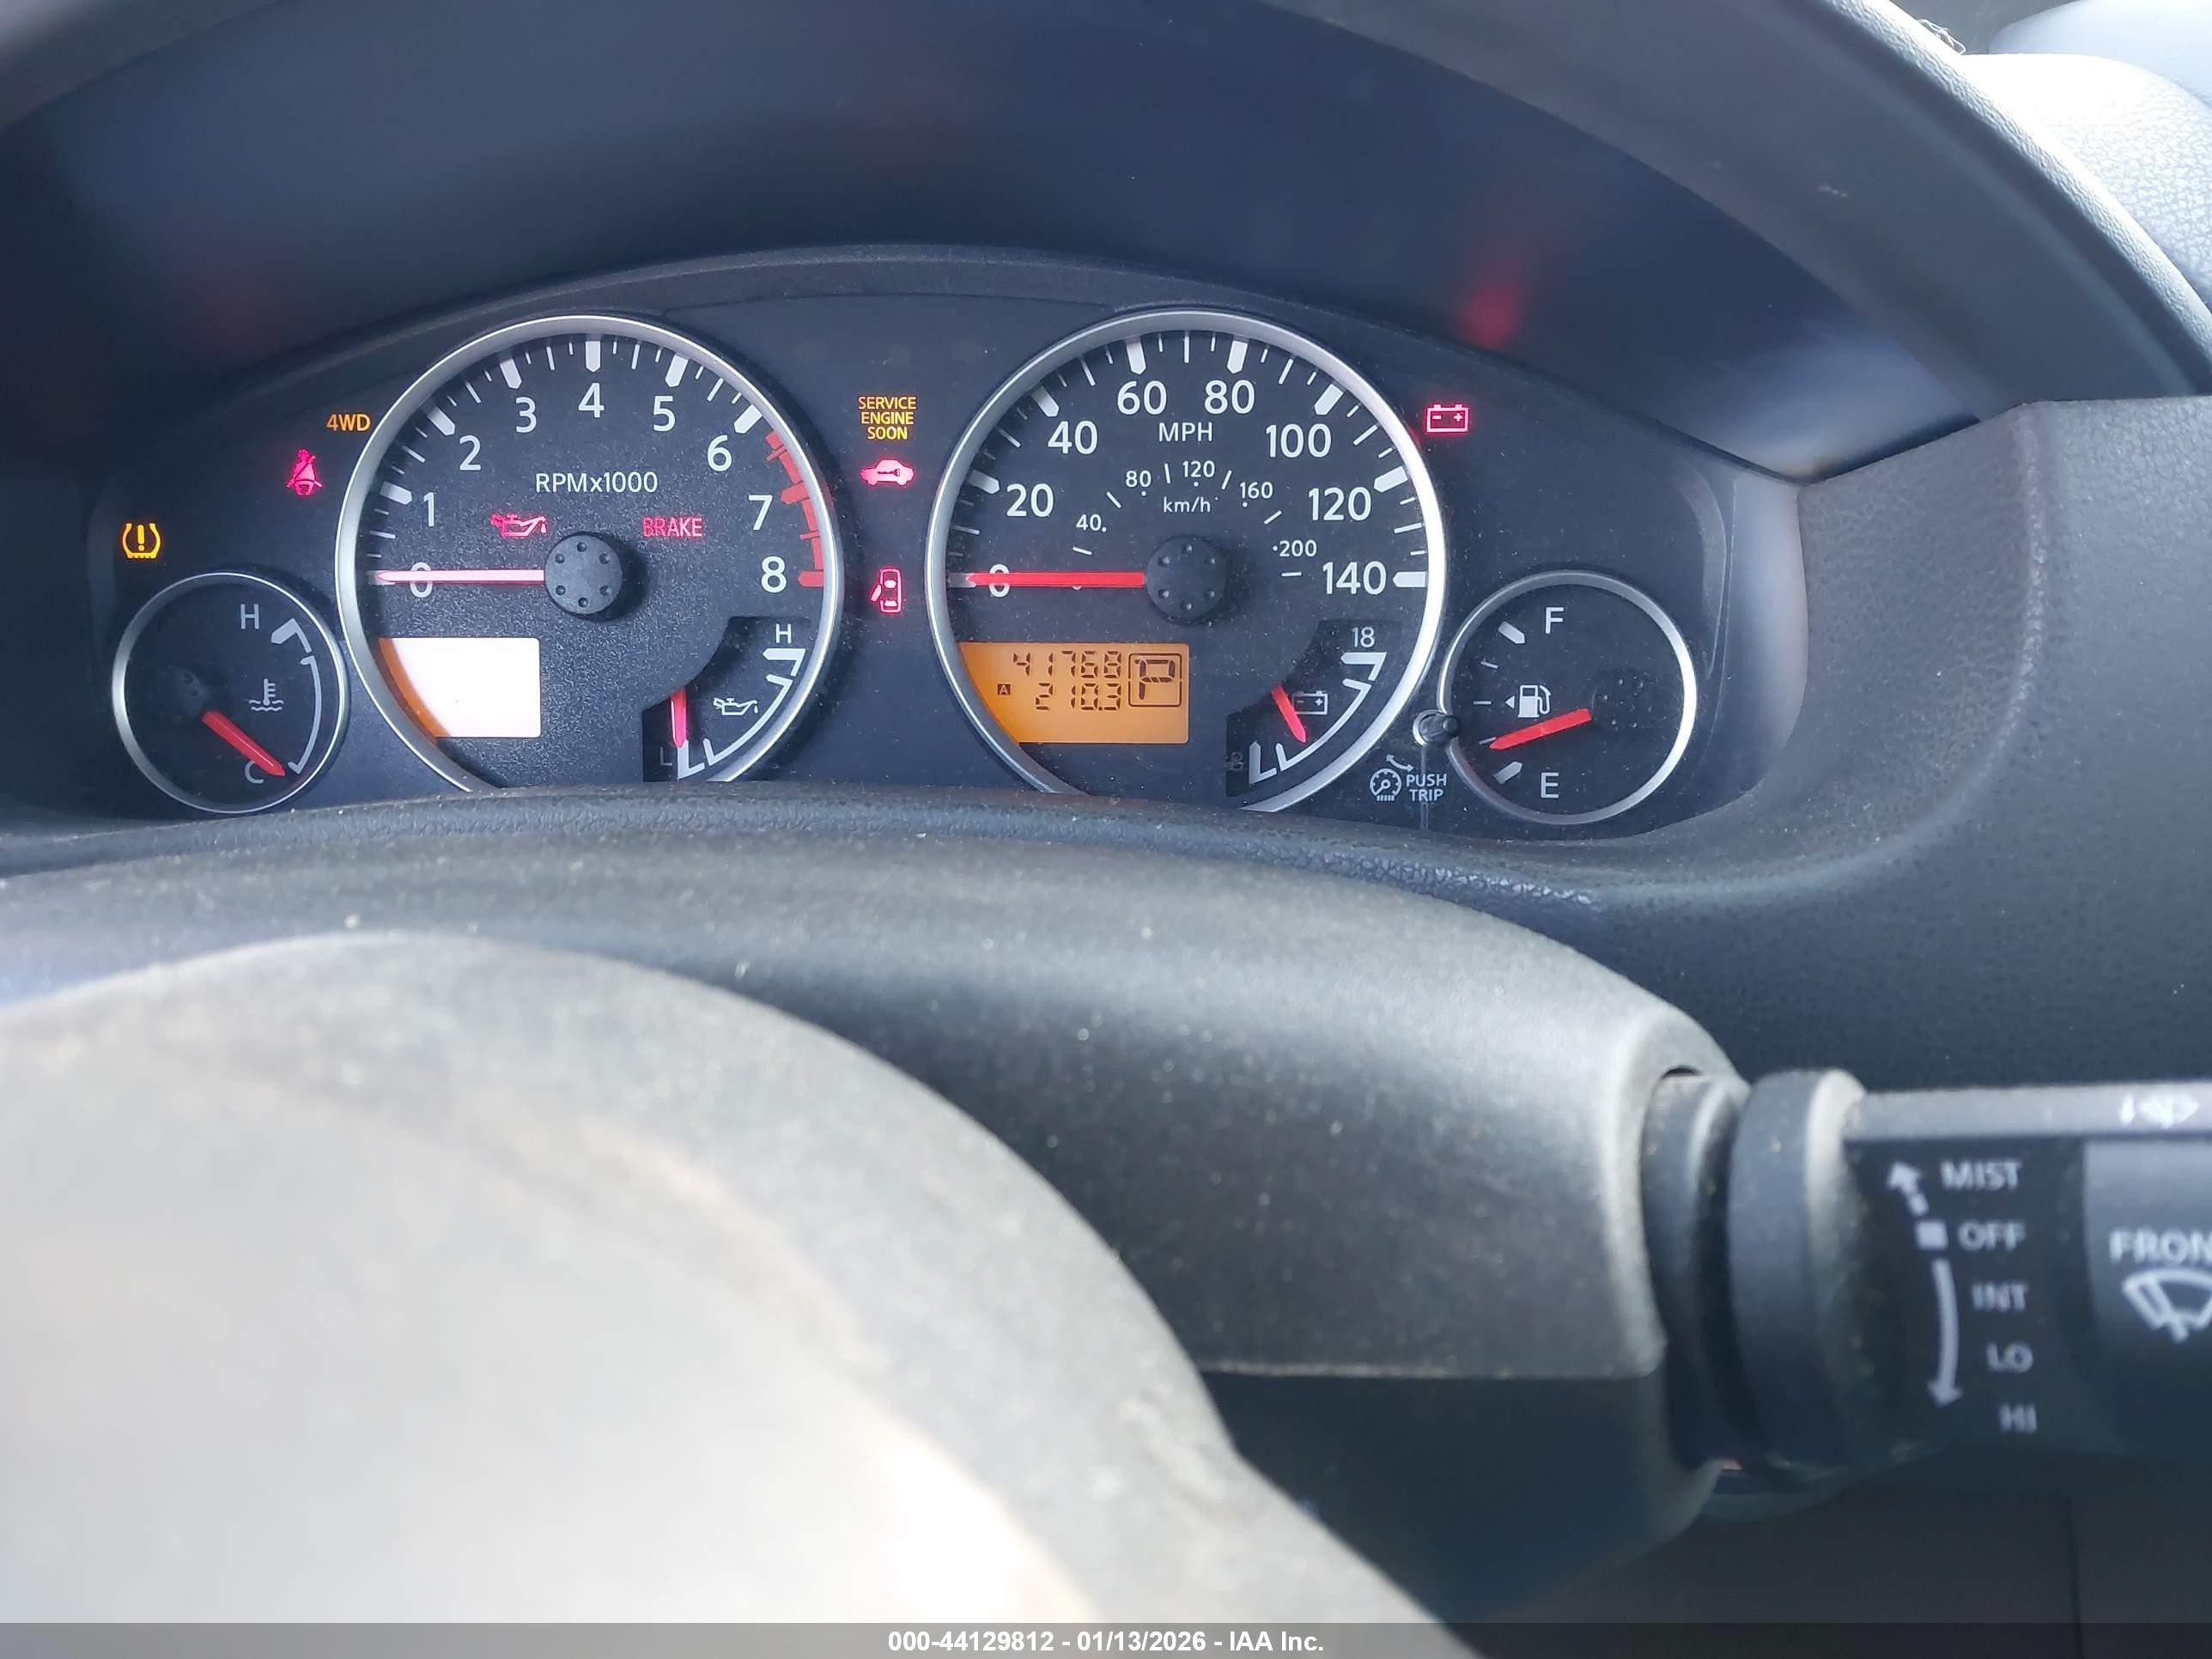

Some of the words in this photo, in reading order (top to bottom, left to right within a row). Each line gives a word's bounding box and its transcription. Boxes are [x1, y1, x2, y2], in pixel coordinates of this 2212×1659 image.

[578, 384, 604, 417] 4
[859, 396, 916, 410] SERVICE
[1117, 381, 1167, 415] 60
[1205, 380, 1255, 414] 80
[326, 414, 370, 431] 4WD
[516, 397, 536, 432] 3
[653, 396, 675, 431] 5
[861, 411, 914, 425] ENGINE
[867, 426, 908, 441] SOON
[1048, 421, 1097, 454] 40
[1158, 422, 1212, 441] MPH
[1266, 423, 1332, 458] 100
[459, 436, 481, 470] 2
[708, 435, 732, 471] 6
[1126, 471, 1151, 488] 80
[1182, 461, 1215, 478] 120
[1006, 483, 1054, 517] 20
[1240, 482, 1273, 499] 160
[1309, 487, 1371, 520] 120
[423, 493, 434, 526] 1
[749, 495, 773, 530] 7
[1164, 495, 1211, 514] km/h
[642, 517, 702, 537] BRAKE
[1077, 514, 1102, 531] 40
[1279, 540, 1316, 556] 200
[410, 562, 432, 598] 0
[762, 556, 786, 592] 8
[989, 563, 1010, 598] 0
[1323, 562, 1386, 594] 140
[240, 605, 258, 629] H
[1546, 607, 1564, 633] F
[775, 624, 792, 643] H
[1352, 628, 1374, 647] 18
[1013, 651, 1122, 678] 41768
[1134, 659, 1176, 700] P
[1036, 683, 1121, 711] 210.3
[660, 747, 672, 766] L
[1407, 774, 1447, 787] PUSH
[1409, 787, 1443, 801] TRIP
[1541, 772, 1559, 799] E
[1941, 1161, 2021, 1189] MIST
[1959, 1222, 2026, 1250] OFF
[1973, 1285, 2027, 1310] INT
[1987, 1344, 2033, 1371] LO
[1999, 1405, 2037, 1432] HI
